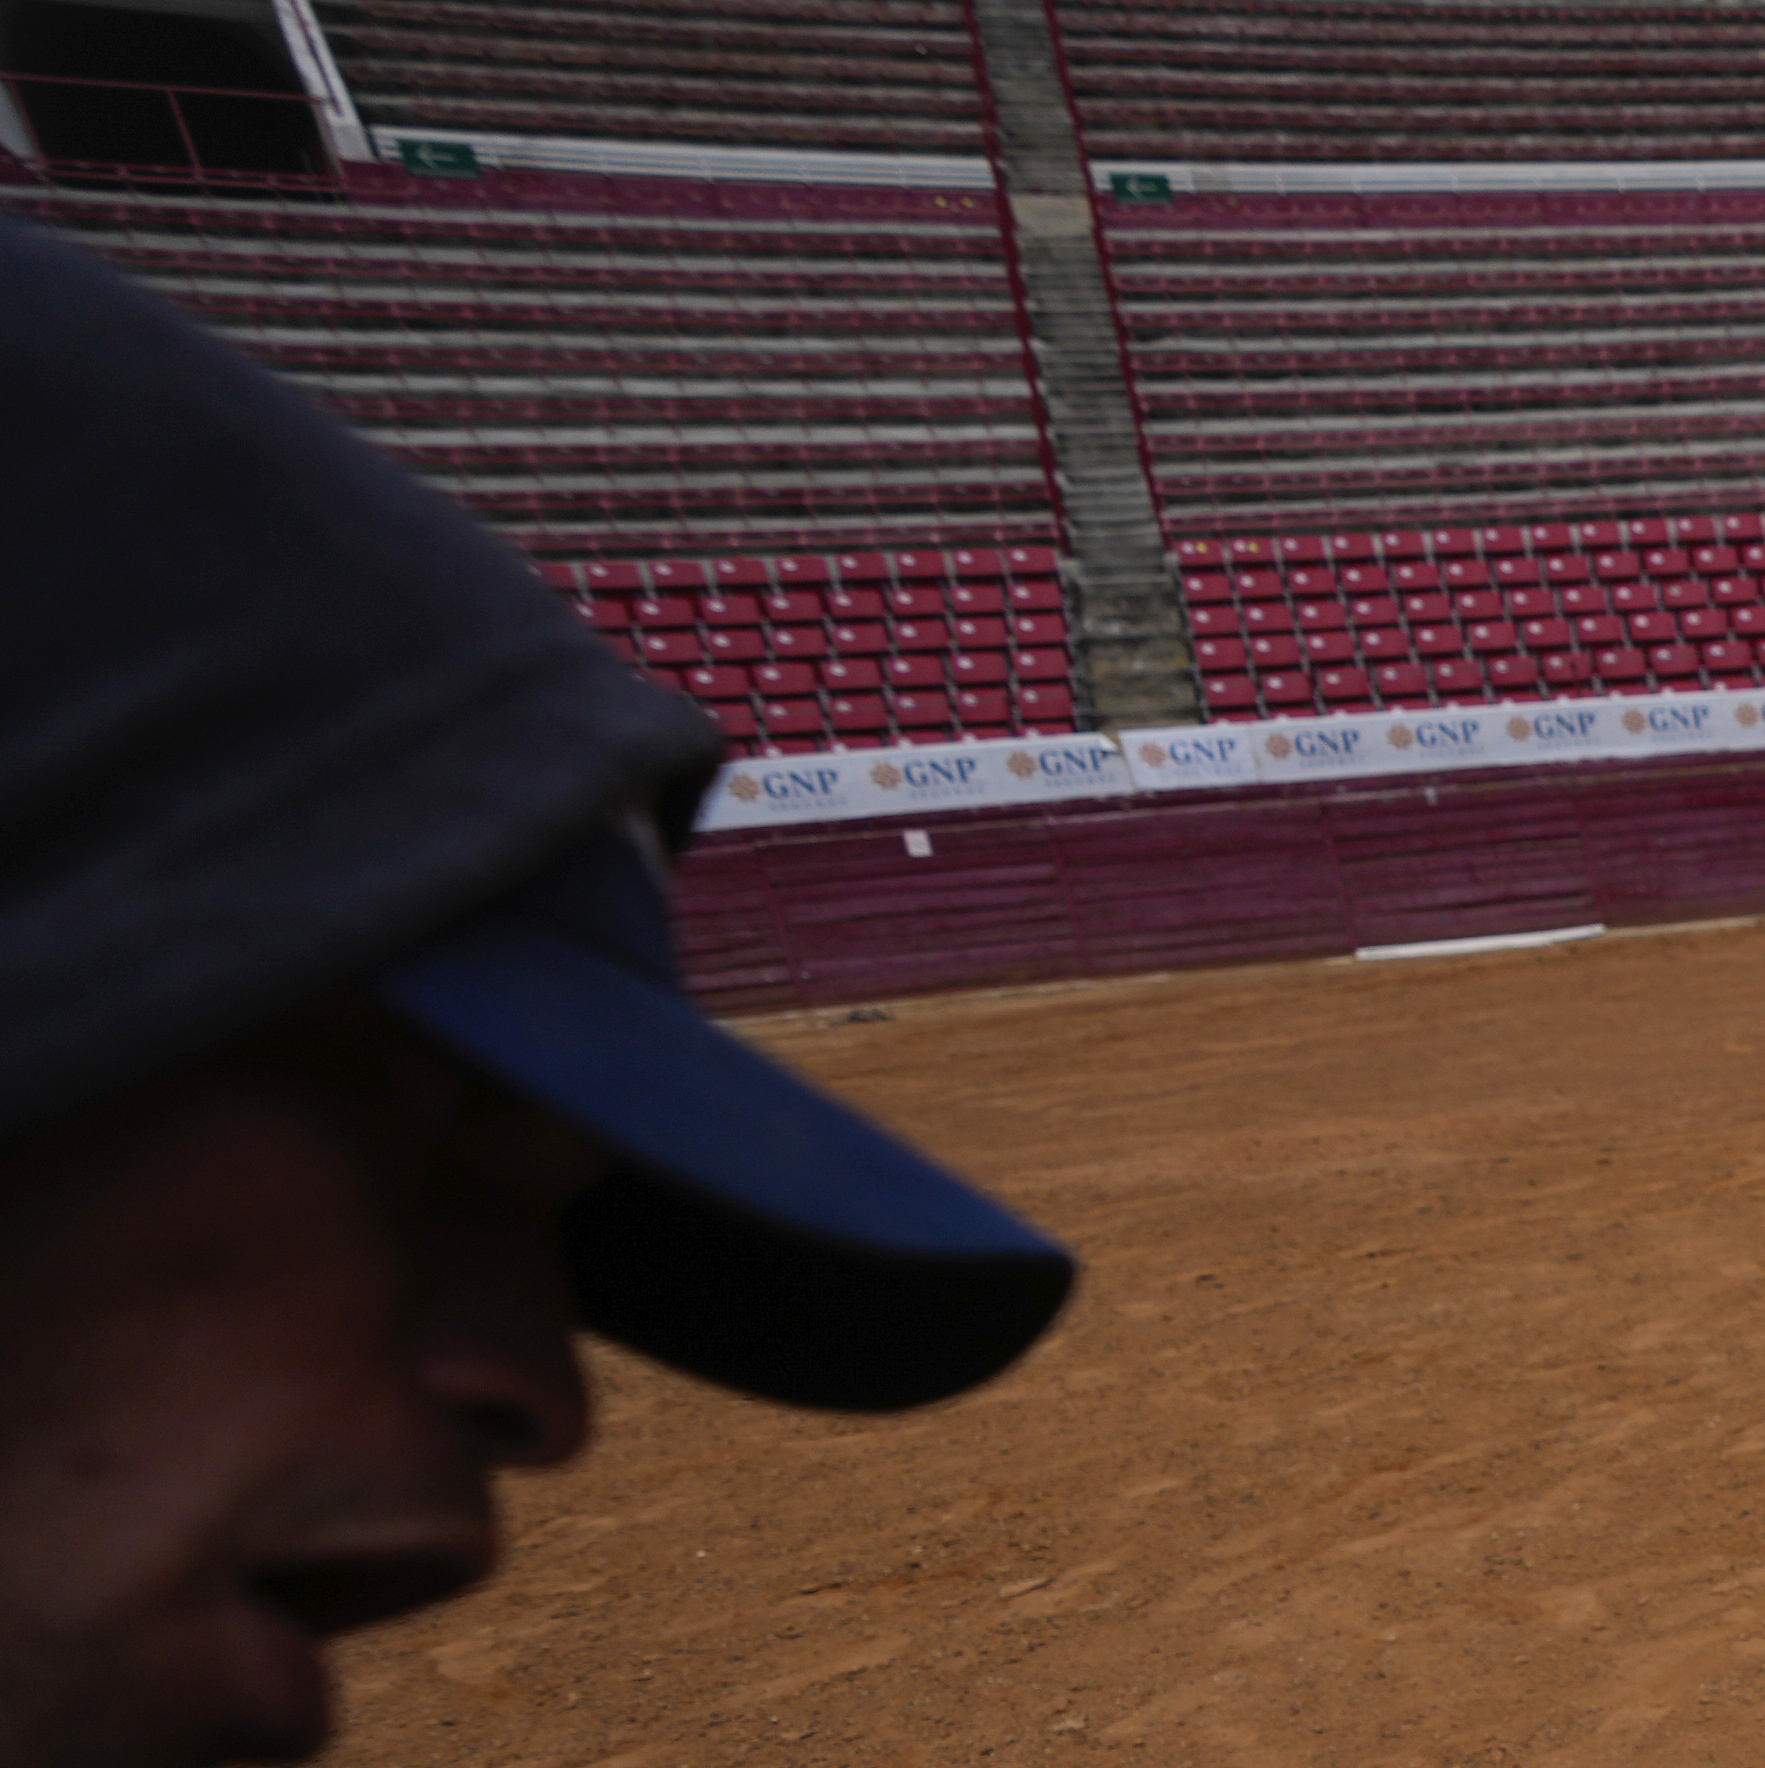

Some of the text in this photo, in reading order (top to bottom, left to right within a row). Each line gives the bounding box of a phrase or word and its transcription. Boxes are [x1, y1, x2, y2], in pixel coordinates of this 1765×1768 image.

[1534, 711, 1596, 739] GNP
[1648, 705, 1709, 733] GNP
[1294, 729, 1360, 758] GNP
[1416, 720, 1479, 748] GNP
[1039, 746, 1110, 776] GNP
[1168, 737, 1237, 766] GNP
[762, 768, 838, 799] GNP
[903, 757, 977, 787] GNP
